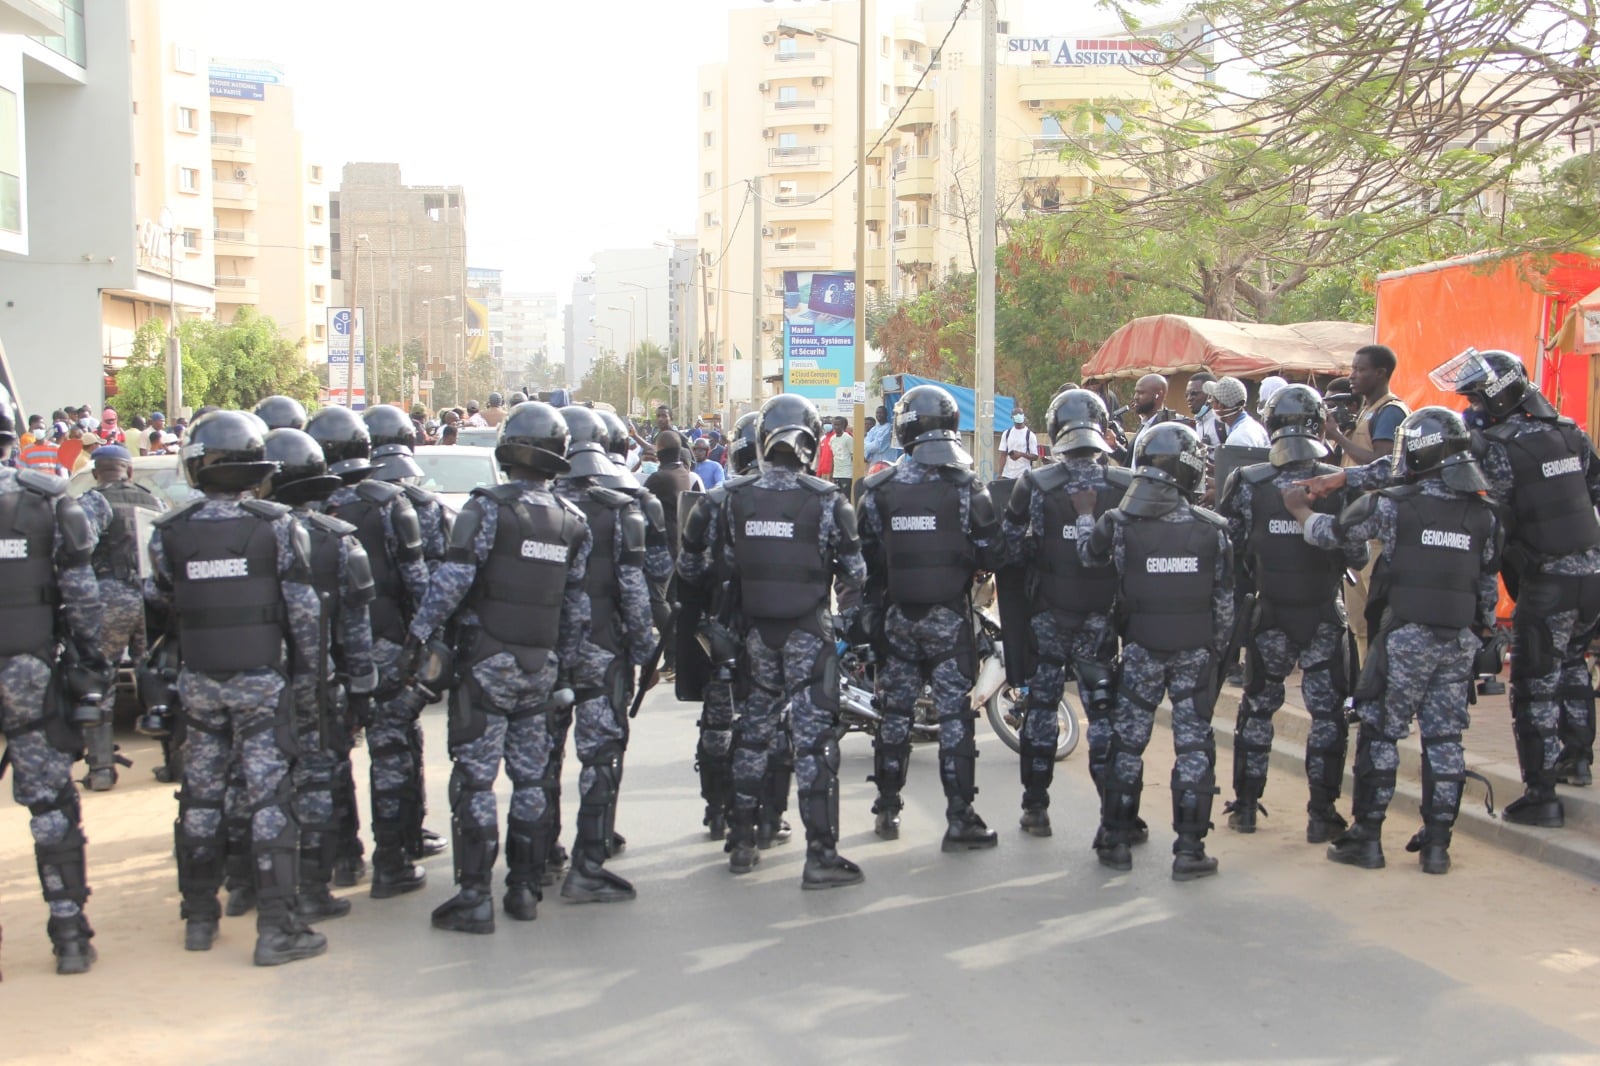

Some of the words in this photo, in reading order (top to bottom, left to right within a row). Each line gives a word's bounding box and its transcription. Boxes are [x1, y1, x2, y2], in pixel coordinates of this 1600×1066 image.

[1008, 39, 1050, 52] SUM
[799, 347, 825, 355] Sécurité
[1407, 432, 1444, 452] GENDARMERIE
[745, 520, 795, 538] GENDARMERIE
[891, 516, 937, 531] GENDARMERIE
[1421, 529, 1471, 550] GENDARMERIE
[186, 557, 249, 580] GENDARMERIE
[1146, 556, 1198, 573] GENDARMERIE
